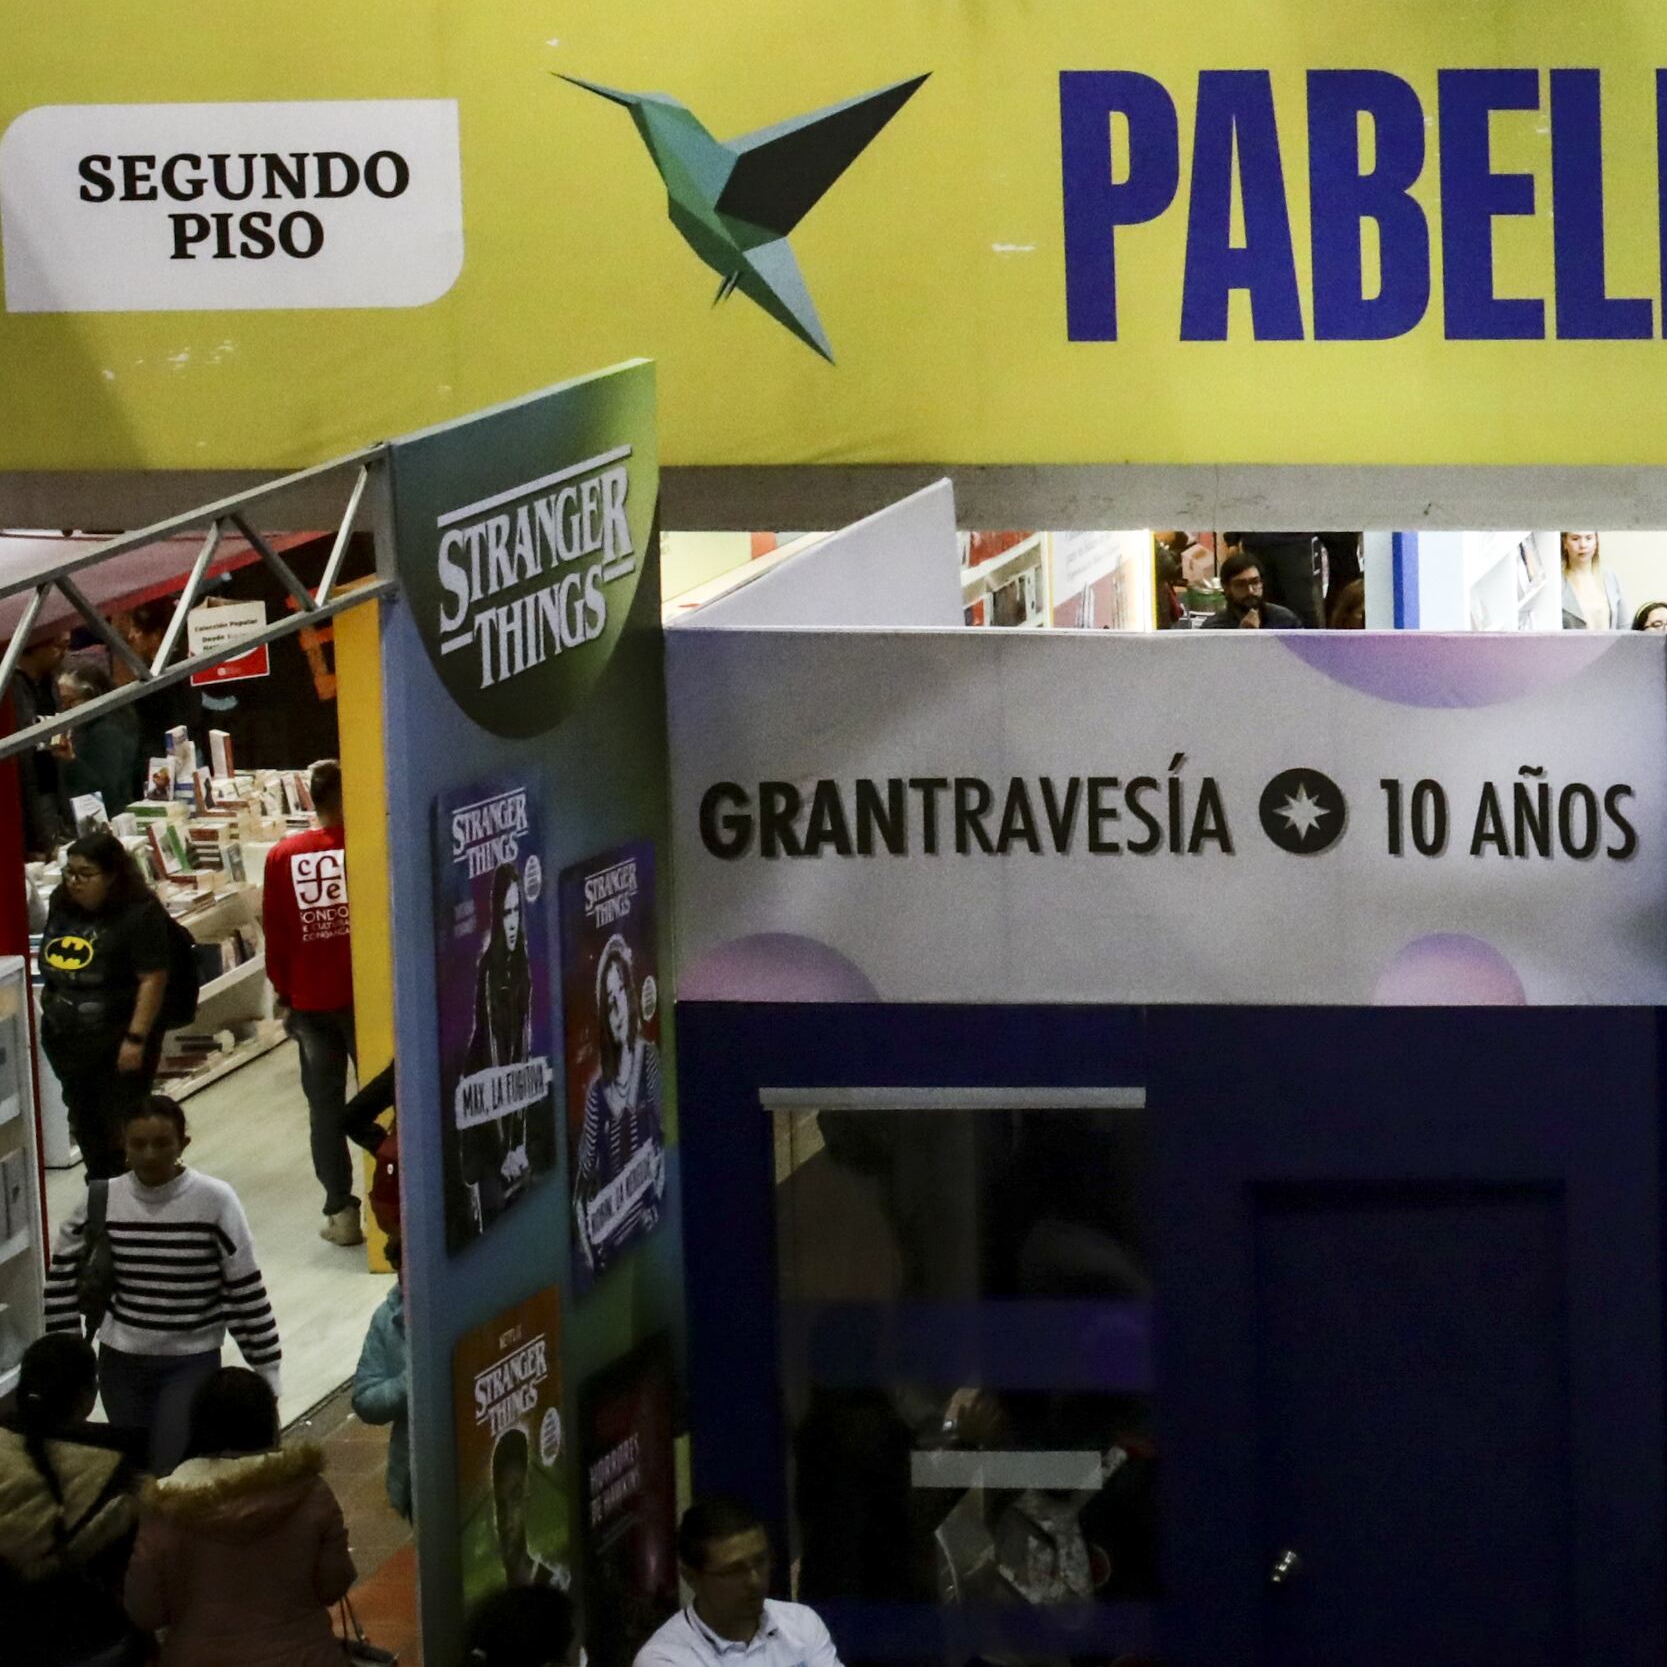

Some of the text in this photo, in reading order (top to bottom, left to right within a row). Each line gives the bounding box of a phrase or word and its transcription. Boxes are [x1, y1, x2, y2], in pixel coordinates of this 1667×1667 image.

[77, 149, 412, 204] SEGUNDO
[168, 210, 326, 261] PISO
[437, 466, 635, 633] STRANGER
[472, 564, 606, 689] THINGS
[452, 789, 529, 852] STRANGER
[698, 752, 1638, 863] GRANTRAVESÍA 10 AÑOS
[466, 830, 519, 879] THINGS
[584, 861, 638, 913] STRANGER
[595, 890, 632, 928] THINGS
[301, 906, 349, 924] ONDO
[474, 1341, 547, 1417] STRANGER
